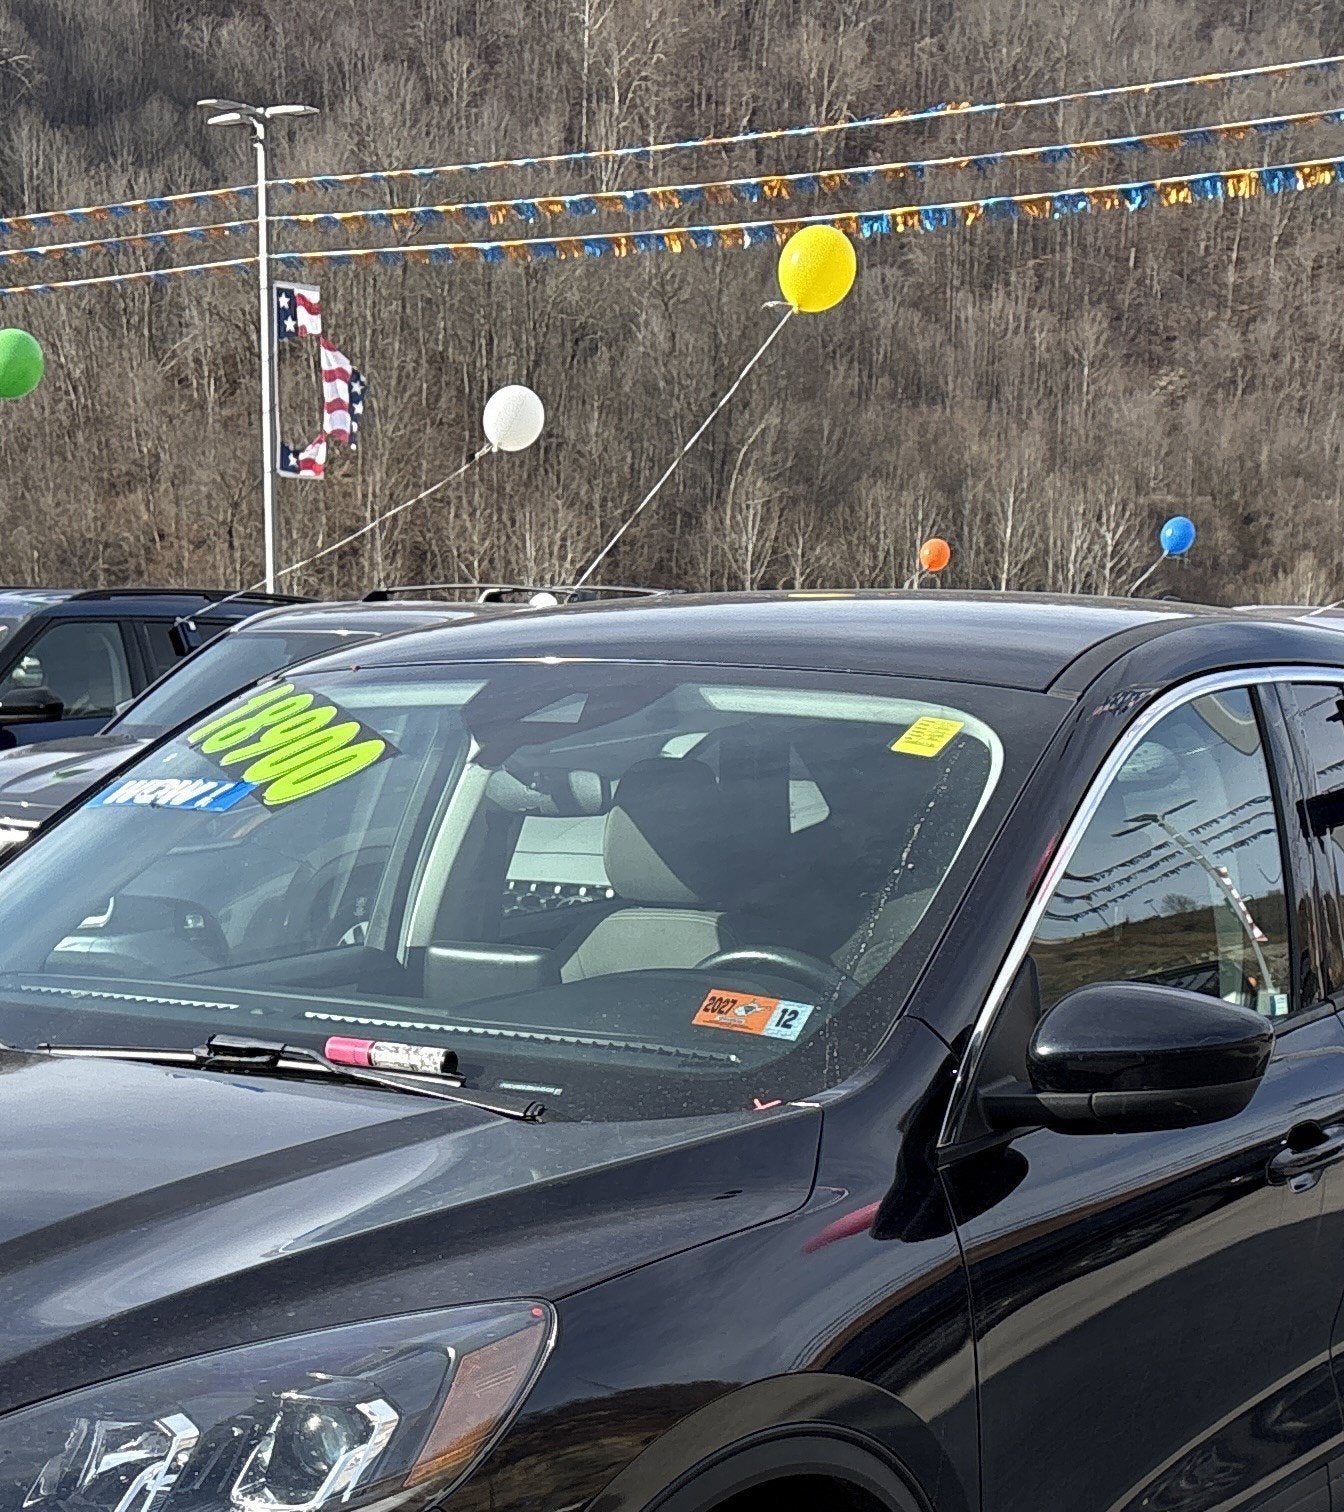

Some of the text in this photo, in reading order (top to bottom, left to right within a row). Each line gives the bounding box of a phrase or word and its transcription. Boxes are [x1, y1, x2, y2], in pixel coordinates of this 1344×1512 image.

[187, 683, 386, 806] 18900
[702, 995, 738, 1015] 2027
[775, 1008, 799, 1029] 12
